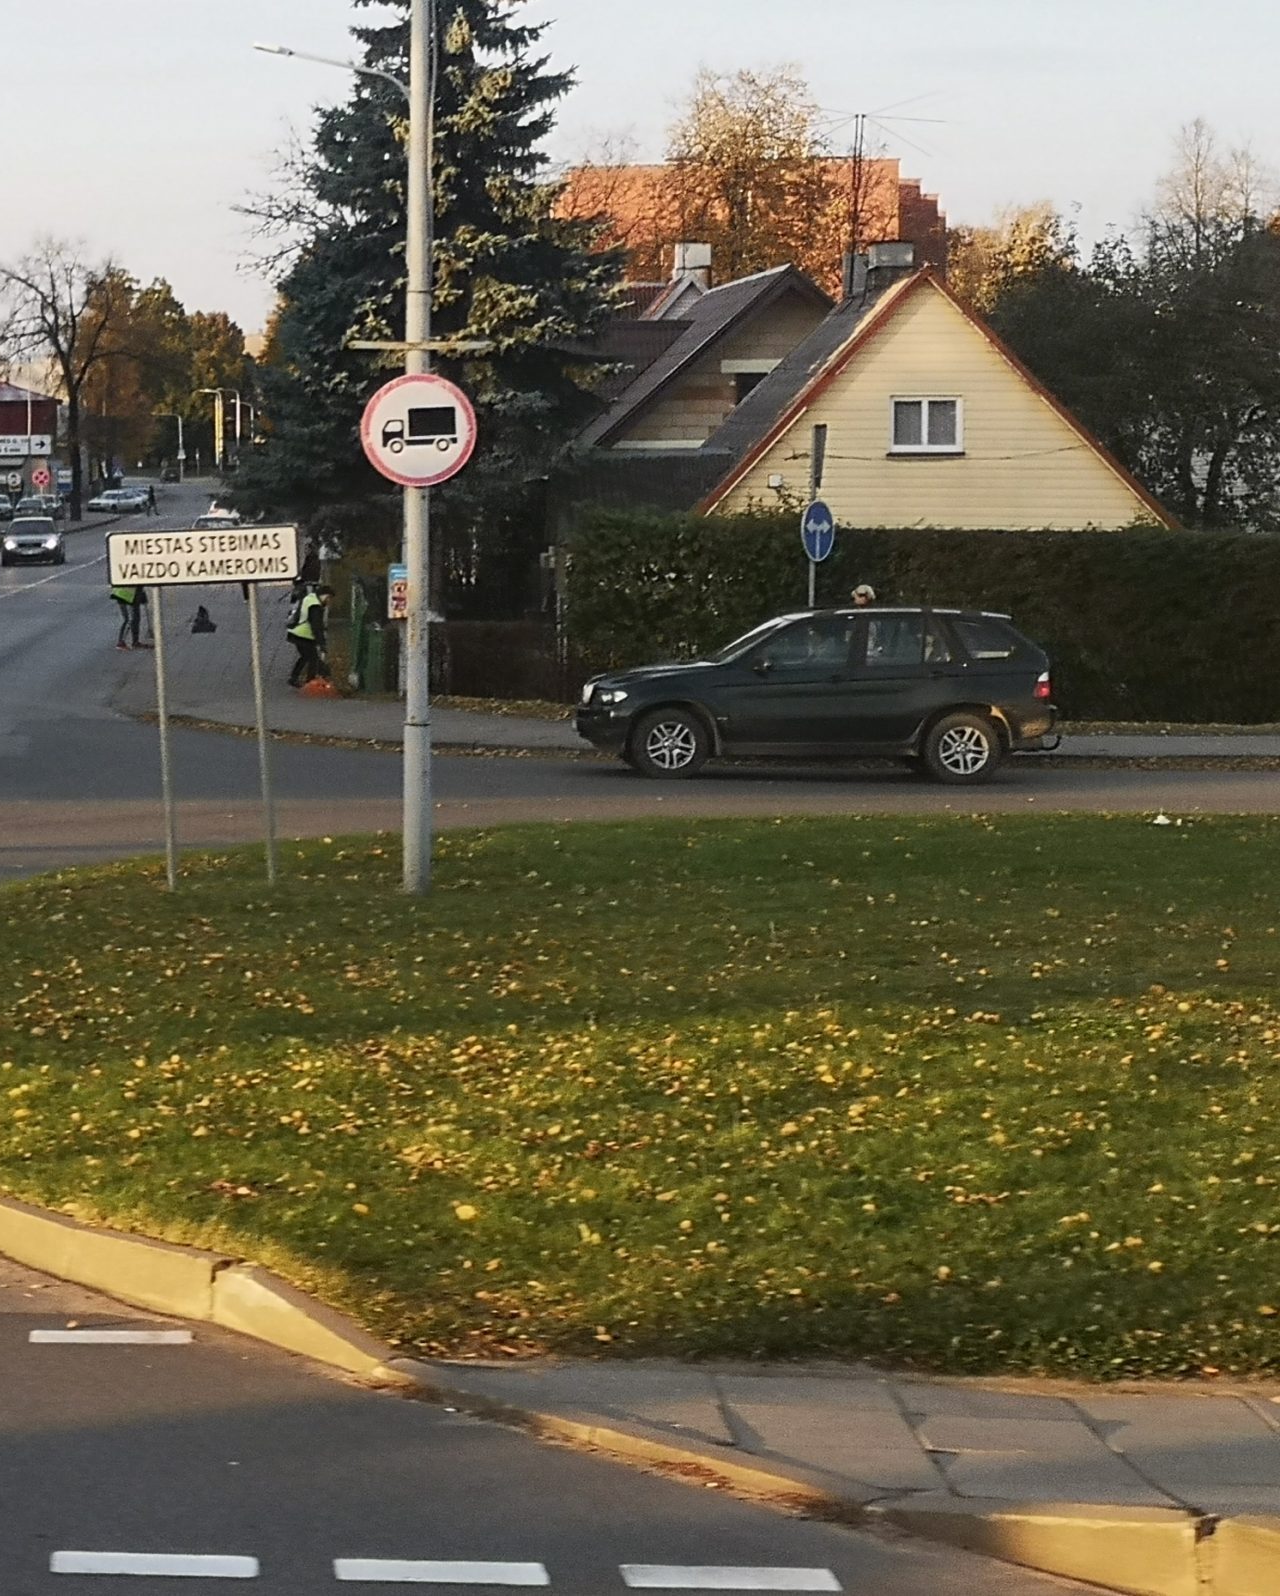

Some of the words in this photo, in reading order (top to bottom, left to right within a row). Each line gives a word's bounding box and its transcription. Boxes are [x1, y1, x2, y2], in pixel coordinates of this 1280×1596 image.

[124, 536, 194, 557] MIESTAS
[198, 532, 282, 554] STEBIMAS
[118, 560, 181, 580] VAIZDO
[185, 556, 289, 578] KAMEROMIS
